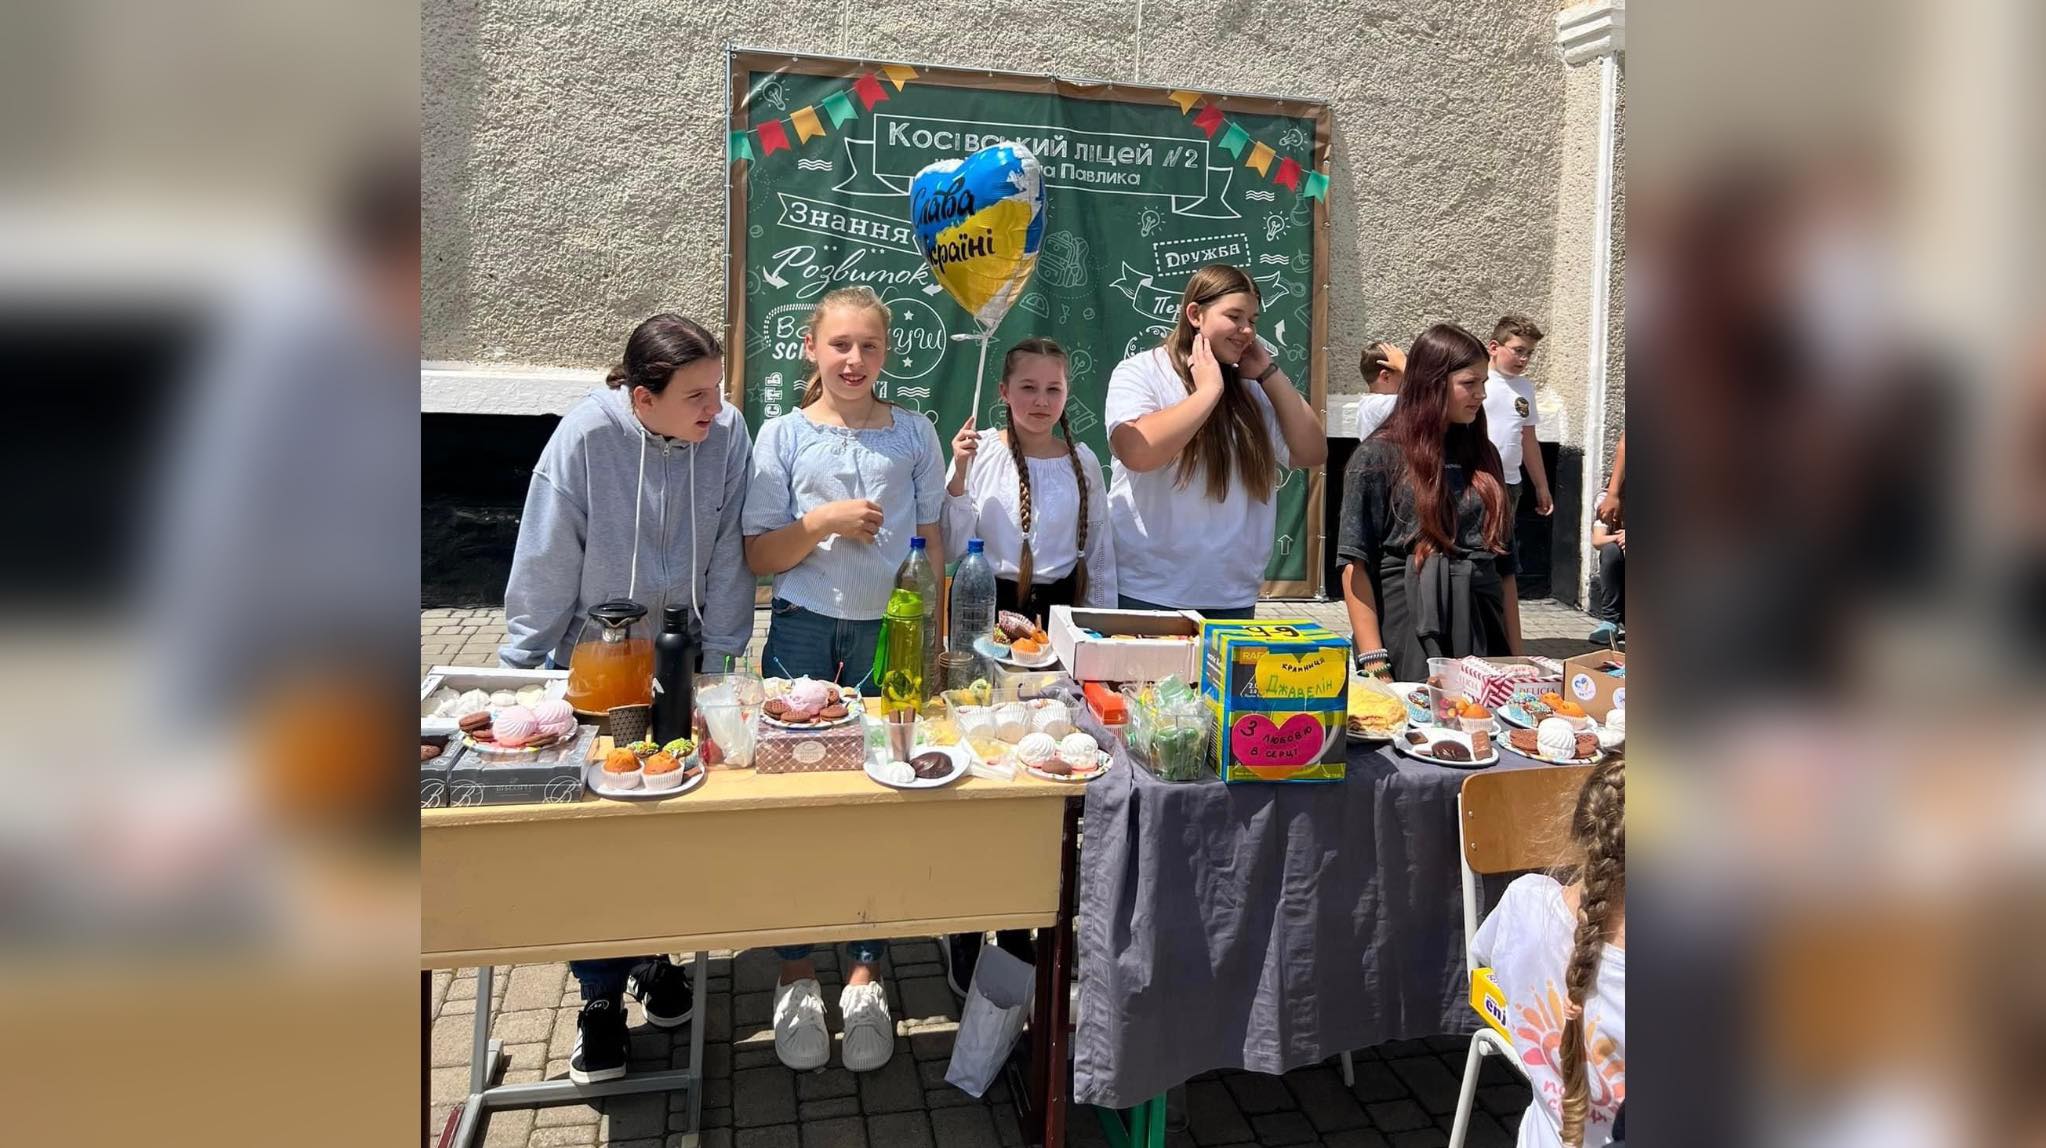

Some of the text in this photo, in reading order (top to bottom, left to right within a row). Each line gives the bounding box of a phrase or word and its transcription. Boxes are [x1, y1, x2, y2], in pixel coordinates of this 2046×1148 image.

[1060, 163, 1140, 186] Павлика
[789, 202, 911, 244] Знання
[913, 177, 976, 228] Слава
[772, 245, 930, 299] Розвиток
